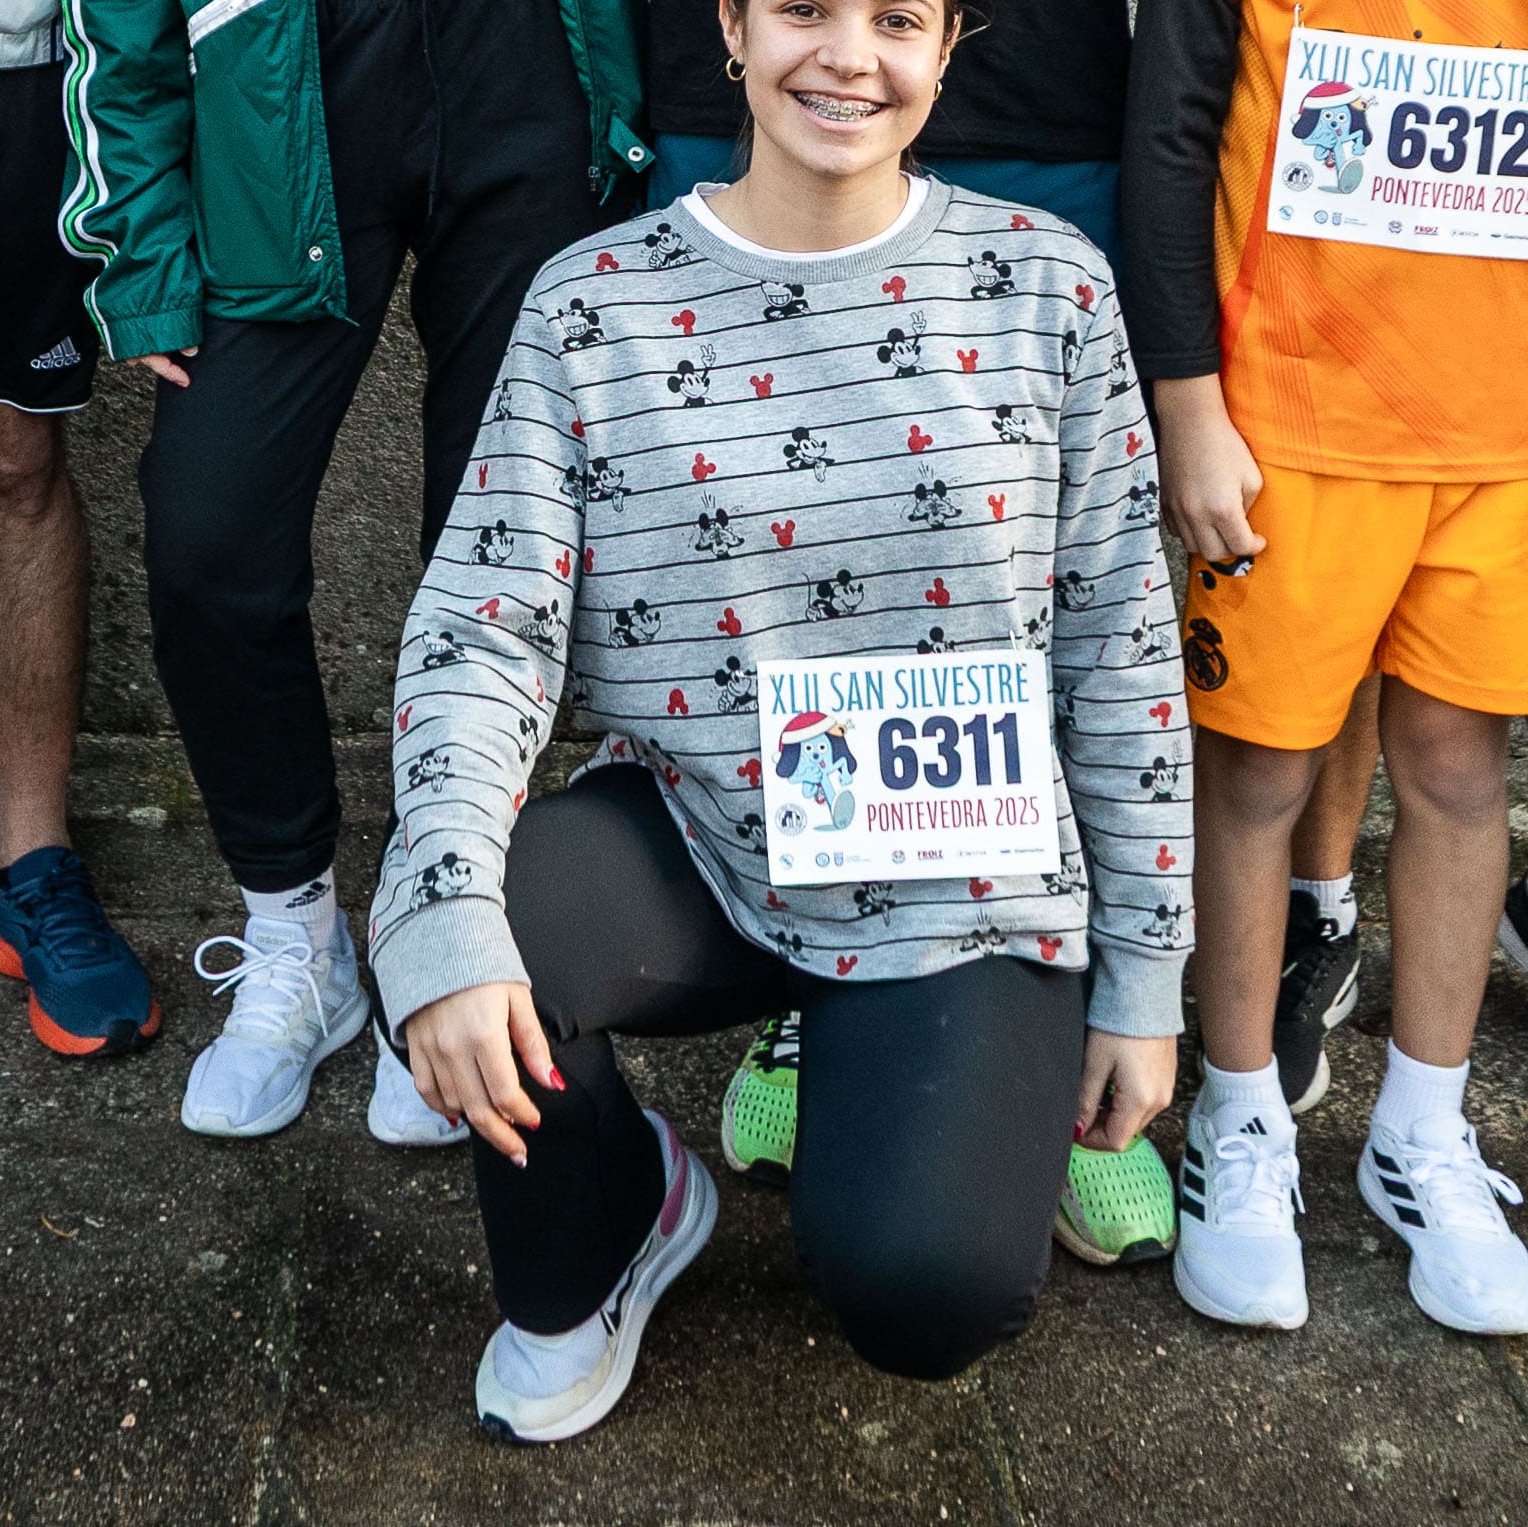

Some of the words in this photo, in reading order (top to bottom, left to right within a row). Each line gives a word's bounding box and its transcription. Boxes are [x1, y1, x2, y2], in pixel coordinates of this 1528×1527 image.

[1299, 41, 1350, 83] XLII
[1358, 49, 1415, 92] SAN
[1371, 176, 1485, 212] PONTEVEDRA
[770, 673, 820, 714] XLII
[831, 671, 884, 712] SAN
[895, 663, 1030, 708] SILVESTRE
[878, 712, 1022, 790] 6311
[867, 799, 988, 832] PONTEVEDRA
[995, 797, 1039, 825] 2025
